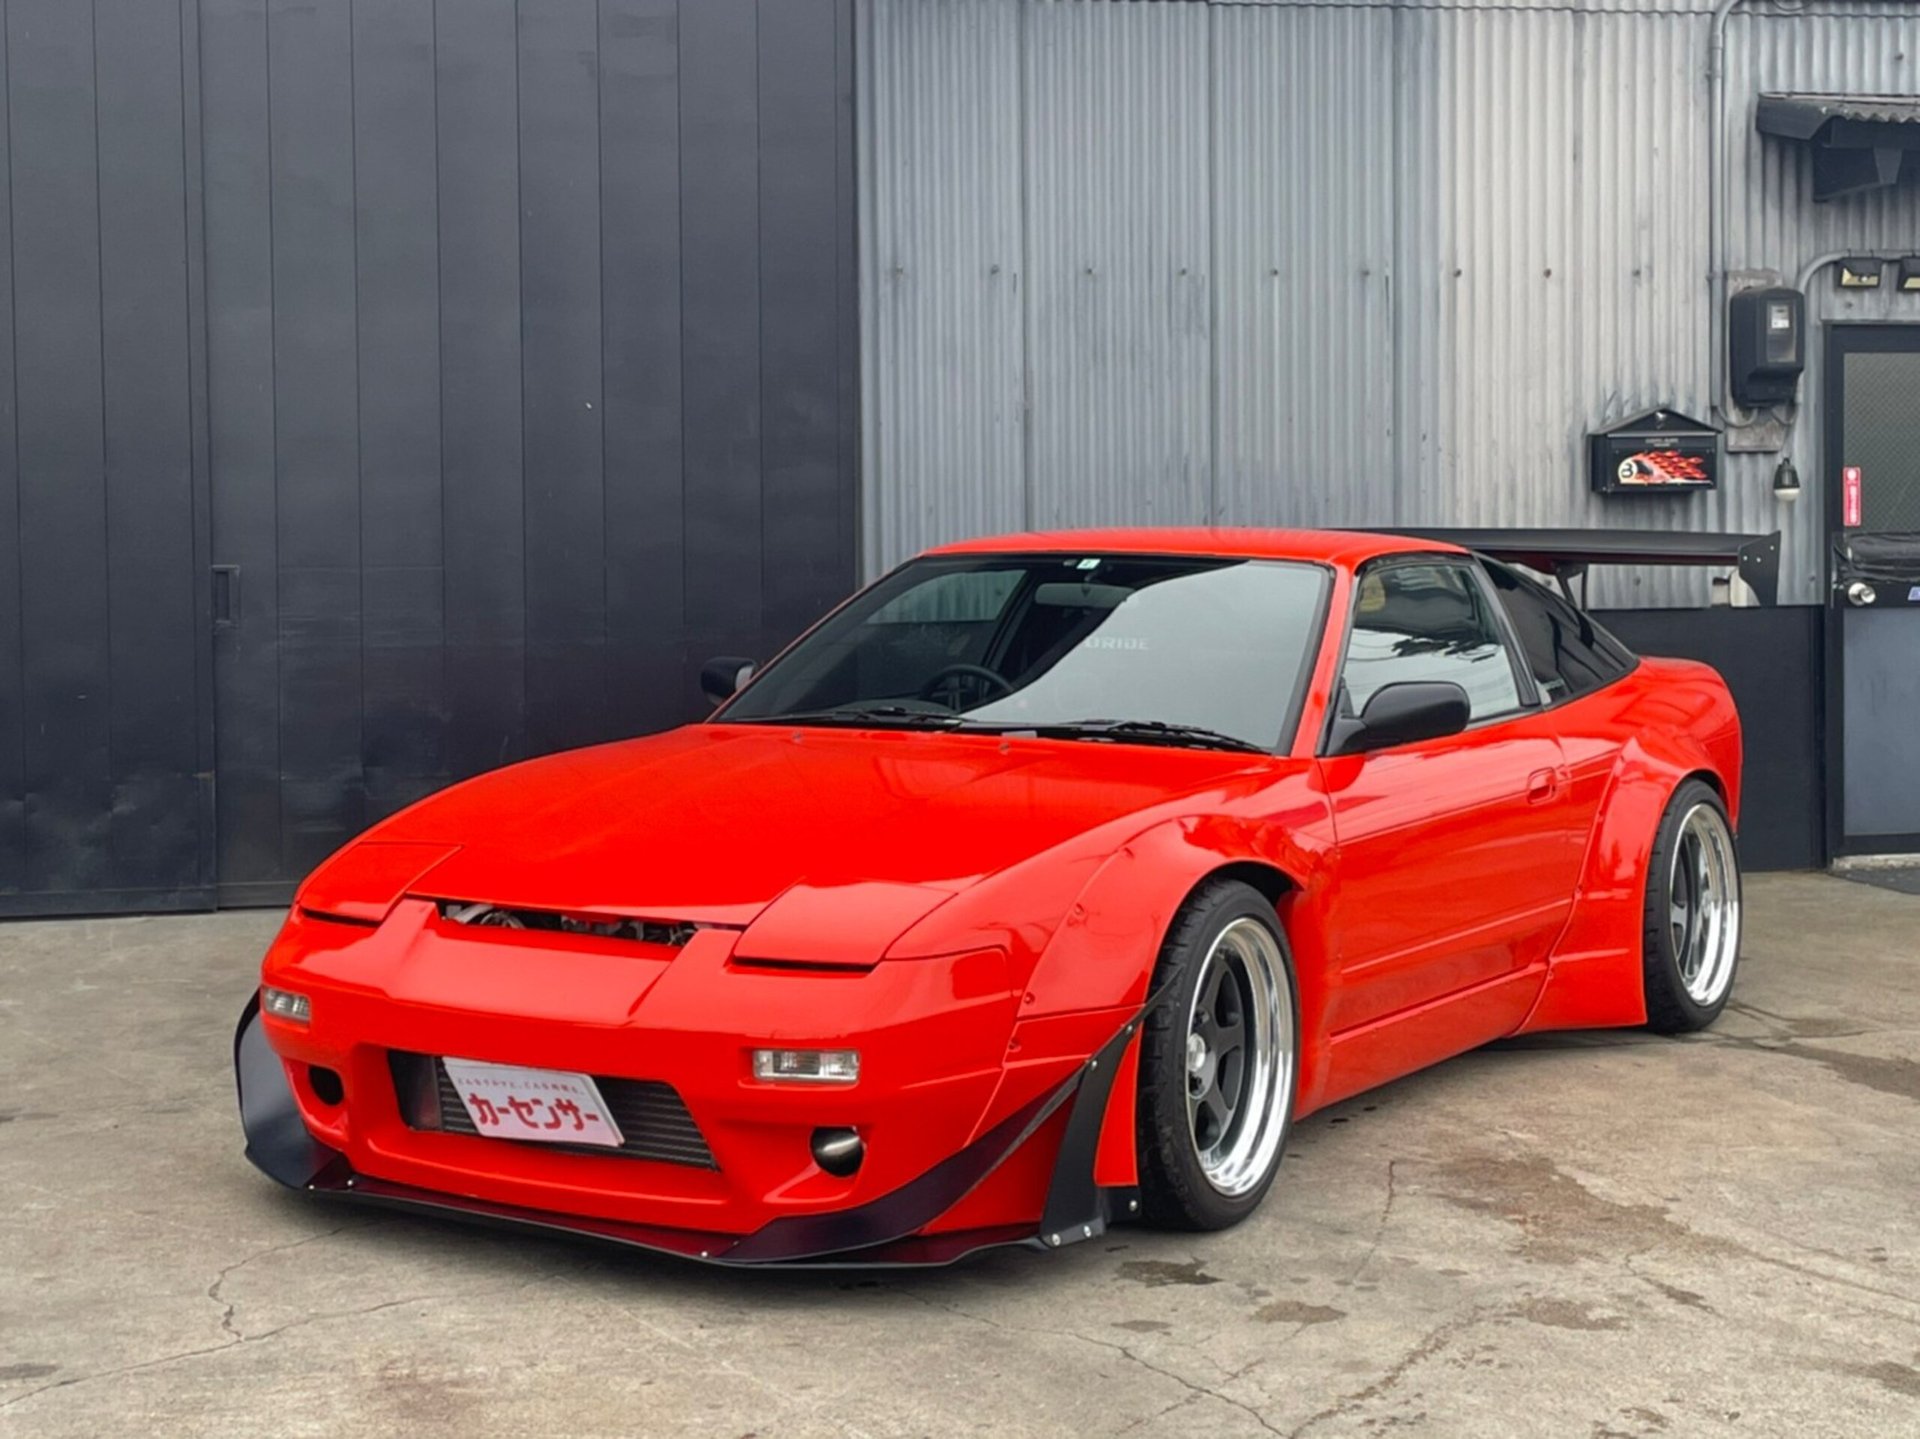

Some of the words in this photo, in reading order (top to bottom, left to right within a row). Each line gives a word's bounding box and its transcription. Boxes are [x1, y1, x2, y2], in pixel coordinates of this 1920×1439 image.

[469, 1092, 599, 1131] カーセンサー
